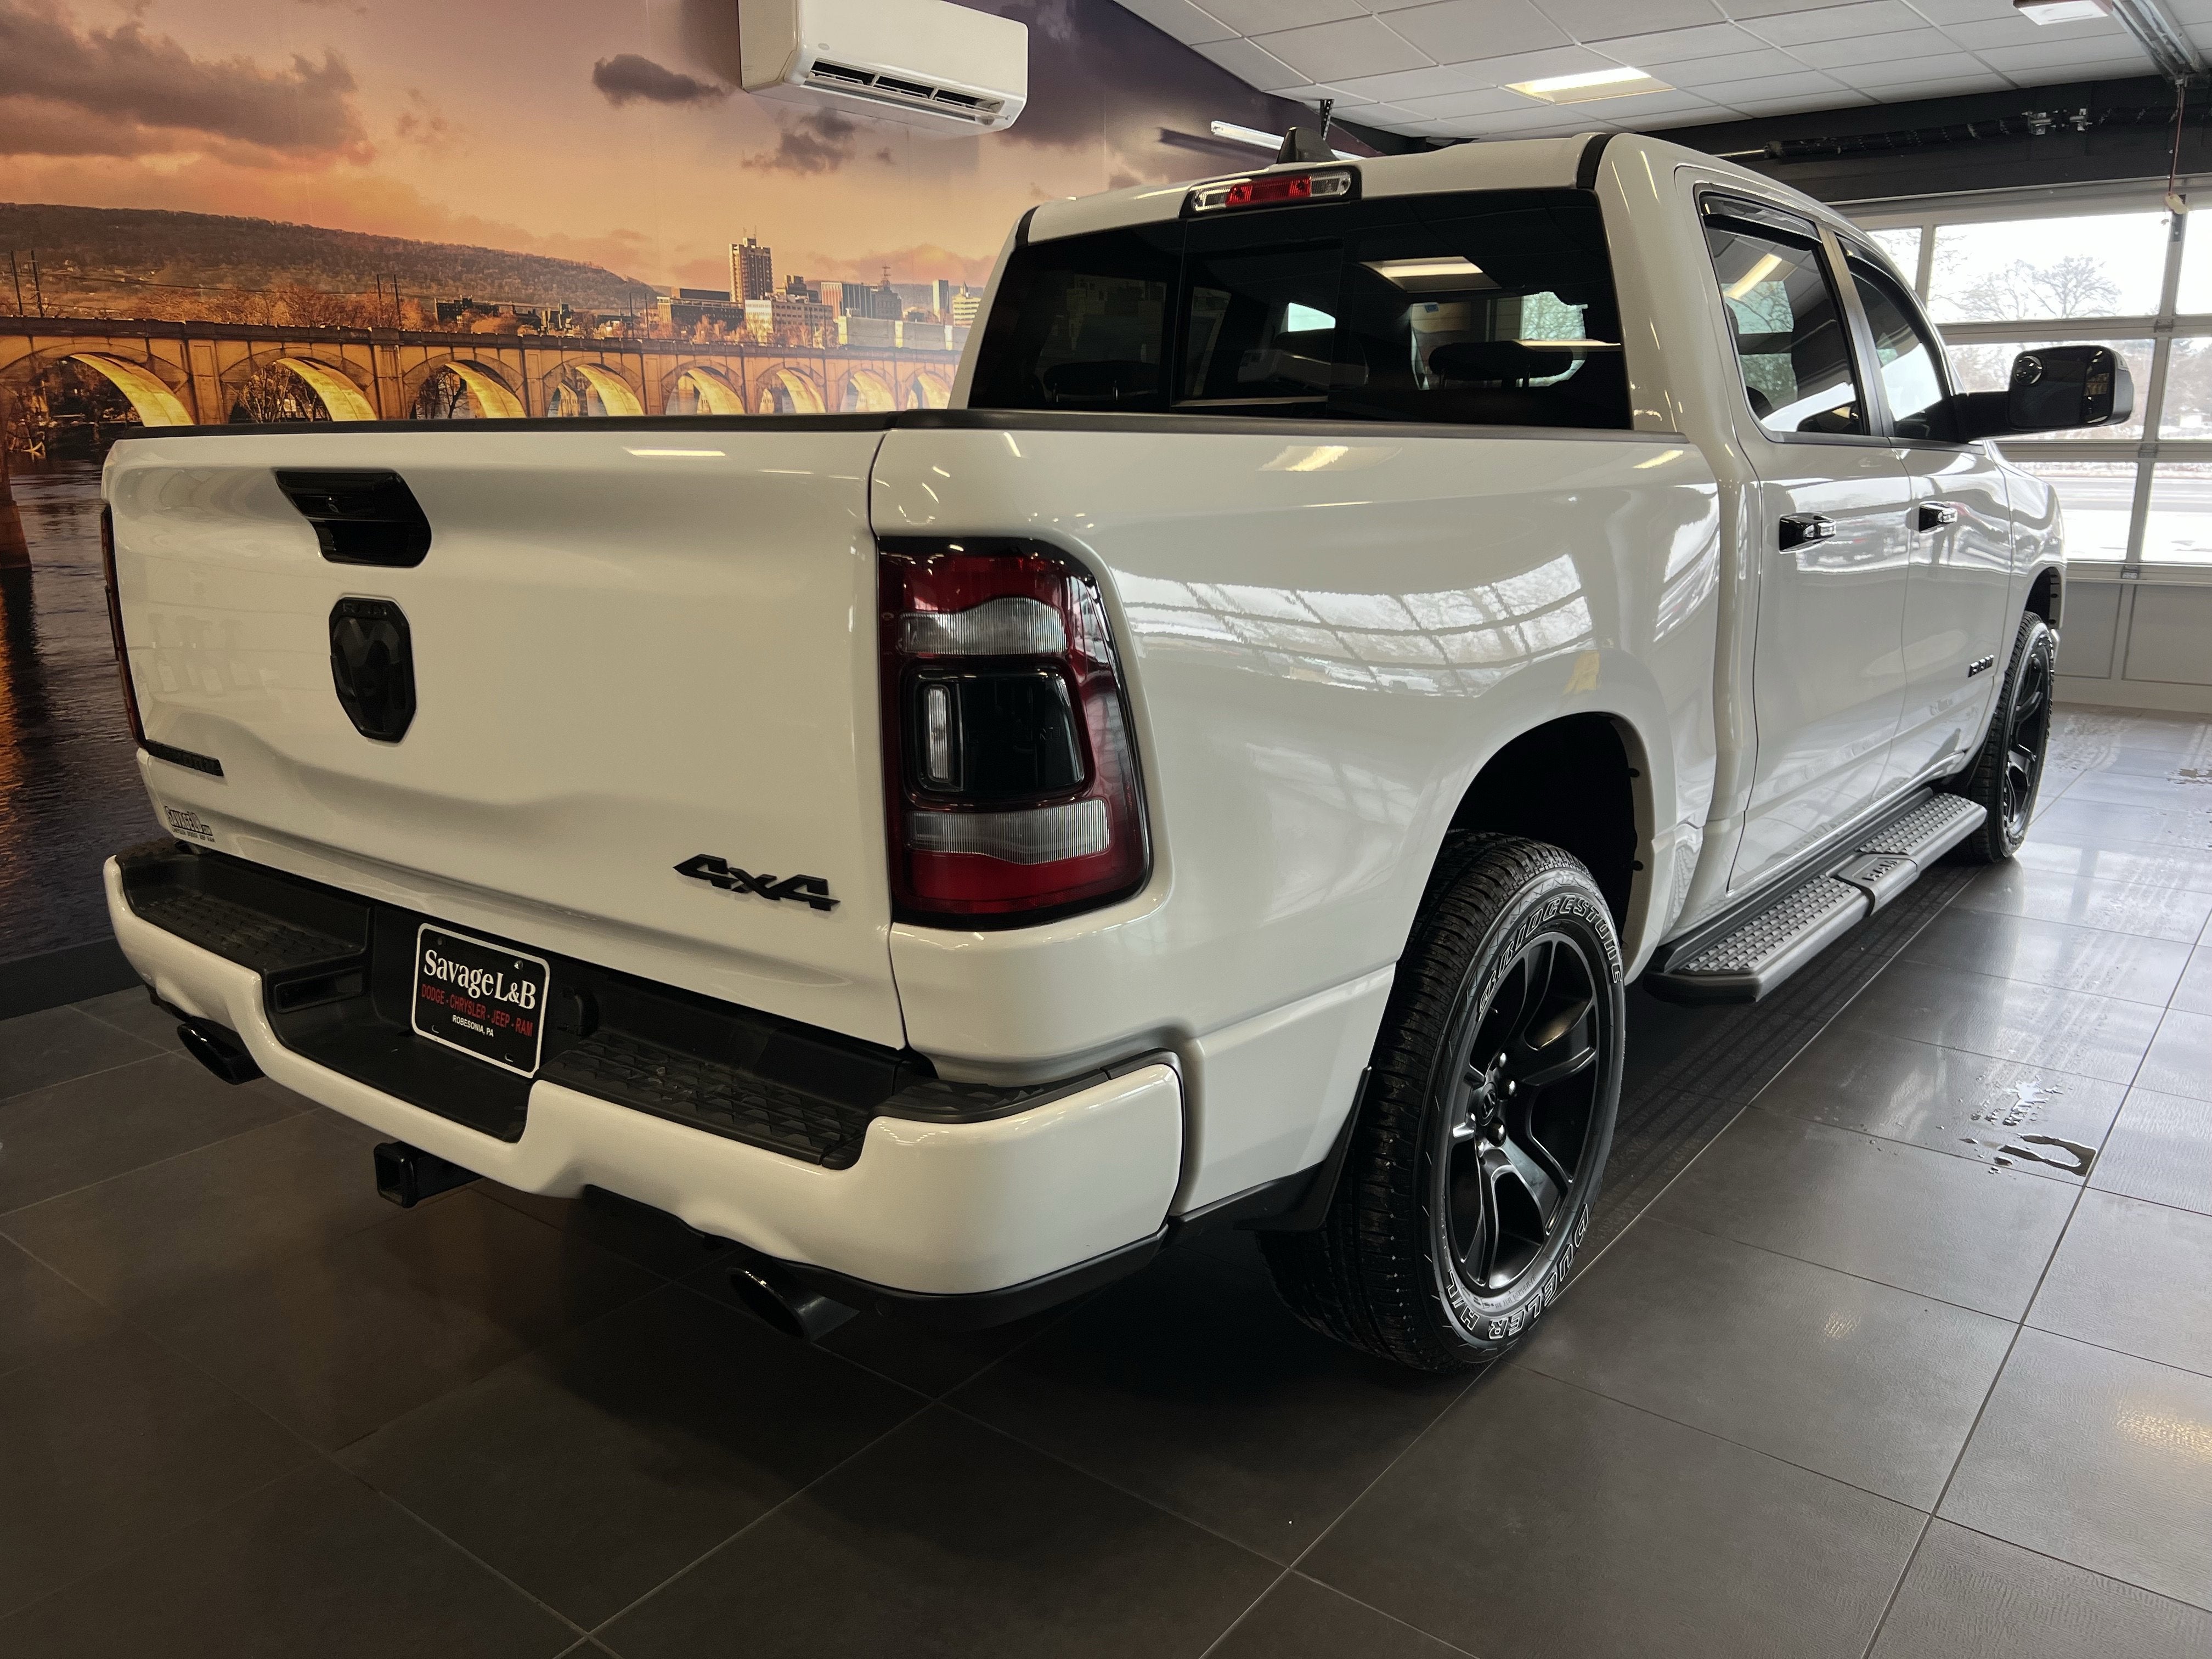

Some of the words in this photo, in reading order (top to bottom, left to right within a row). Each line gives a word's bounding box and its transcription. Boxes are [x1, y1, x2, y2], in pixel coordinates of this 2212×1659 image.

[1968, 654, 1995, 678] RAM
[1862, 859, 1900, 882] RAM
[1477, 895, 1622, 1022] BRIDGESTONE
[421, 984, 445, 1005] DODGE
[449, 994, 486, 1020] CHRYSLER
[491, 1009, 511, 1029] JEEP
[515, 1018, 533, 1037] RAM
[486, 1027, 494, 1037] PA
